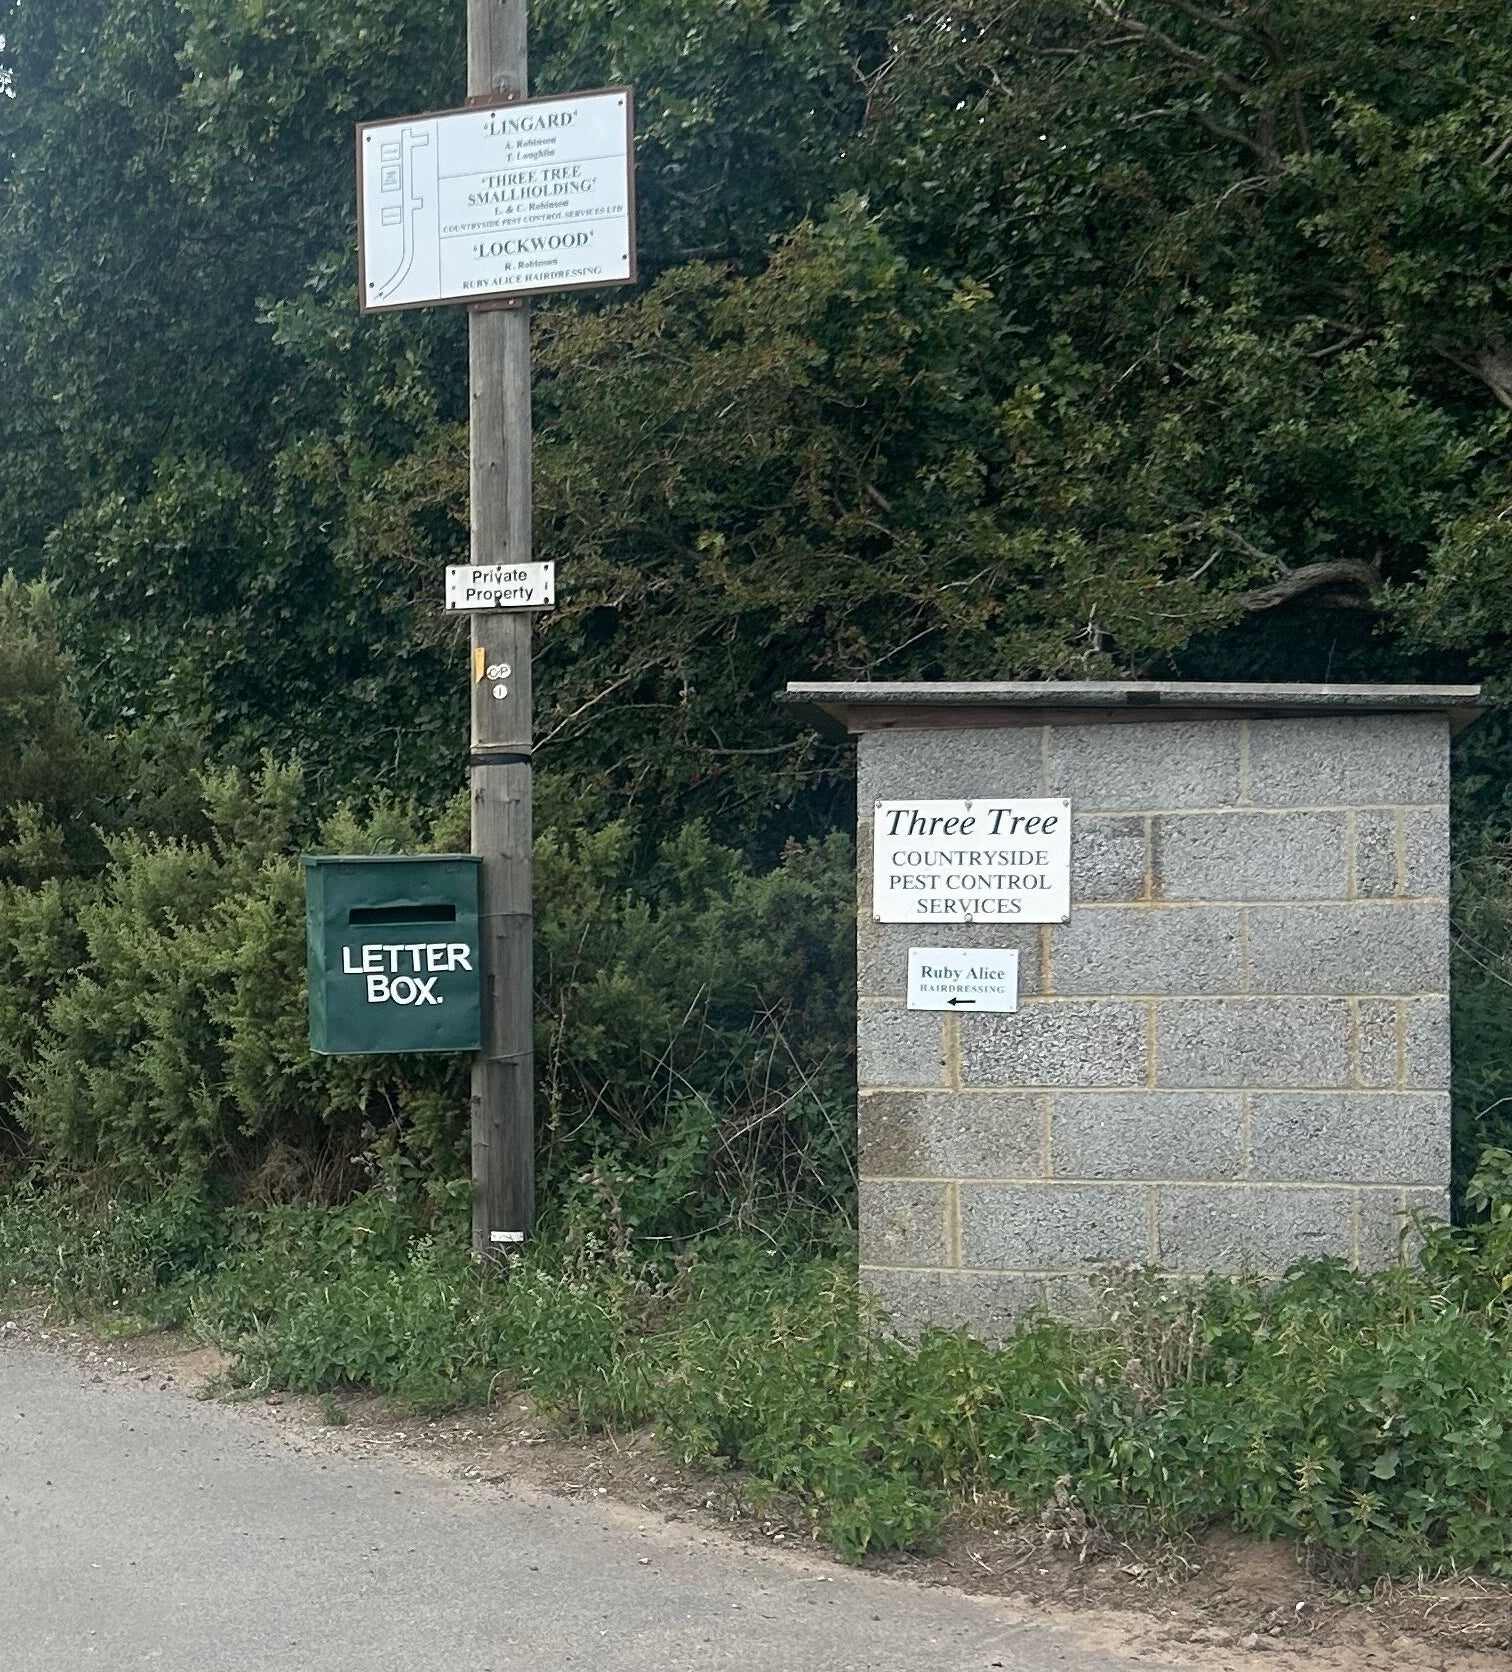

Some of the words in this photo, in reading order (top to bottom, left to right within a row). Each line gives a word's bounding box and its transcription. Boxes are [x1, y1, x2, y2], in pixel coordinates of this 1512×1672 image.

[541, 165, 582, 181] TREE
[506, 204, 514, 213] &
[528, 199, 569, 212] Robinson
[443, 219, 500, 234] COUNTRYSIDE
[502, 217, 521, 226] PEST
[523, 212, 562, 225] CONTROL
[564, 207, 605, 219] SERVICES
[518, 258, 558, 269] Robinson
[462, 279, 489, 290] RUBY
[491, 275, 521, 287] ALICE
[525, 266, 602, 282] HAIRDRESSING
[472, 570, 528, 585] Private
[466, 586, 534, 603] Property
[886, 808, 976, 836] Three
[988, 808, 1058, 836] Tree
[892, 850, 1049, 867] COUNTRYSIDE
[889, 875, 941, 890] PEST
[946, 874, 1052, 890] CONTROL
[917, 898, 1021, 914] SERVICES
[342, 943, 473, 974] LETTER
[921, 965, 962, 982] Ruby
[966, 966, 1006, 981] Alice
[366, 974, 444, 1006] BOX.
[920, 984, 1005, 994] HAIRDRESSING
